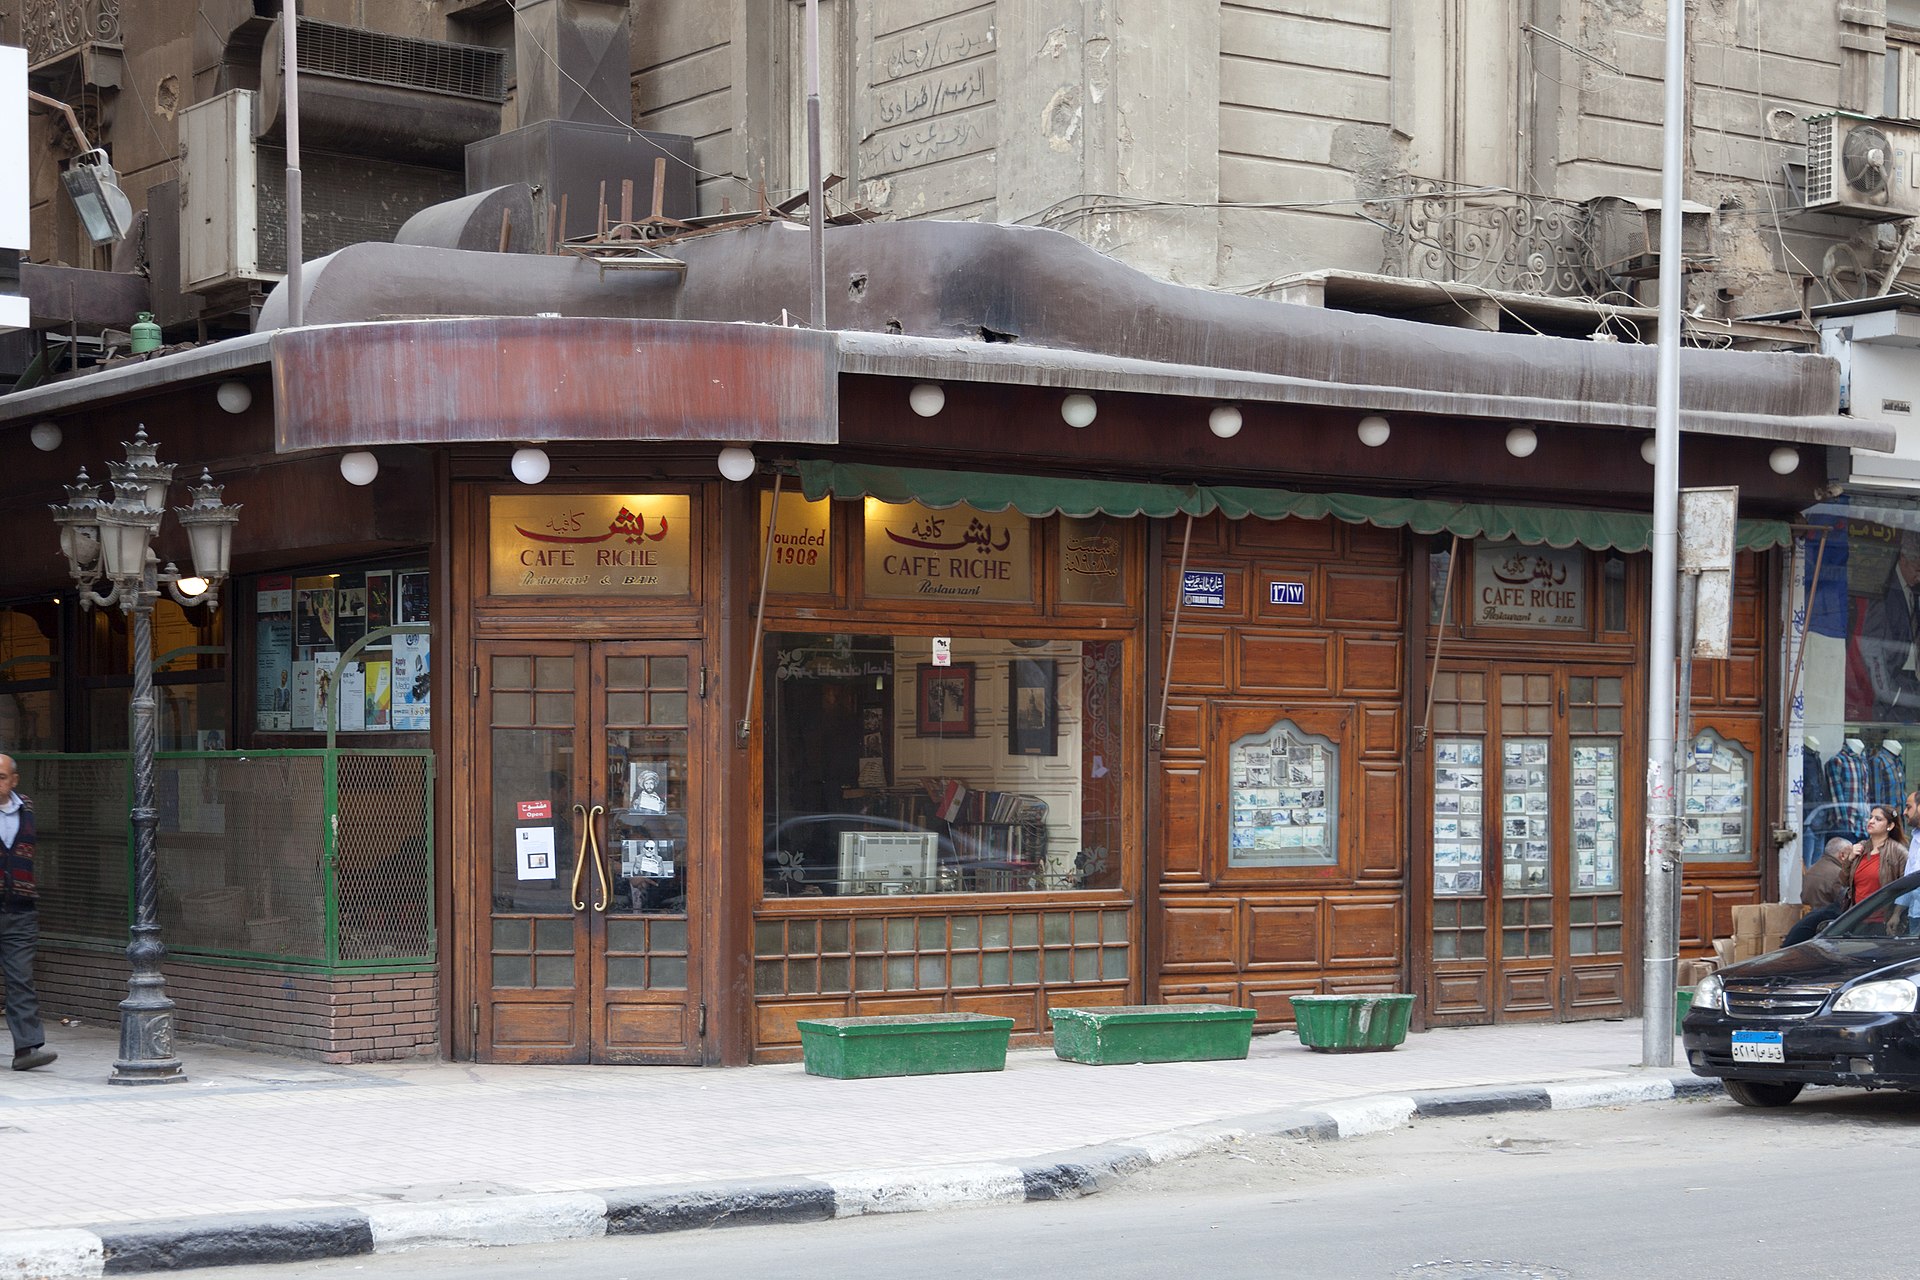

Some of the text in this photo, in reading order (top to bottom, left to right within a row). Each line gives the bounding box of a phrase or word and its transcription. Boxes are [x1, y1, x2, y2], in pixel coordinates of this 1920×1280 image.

[514, 505, 669, 546] كافيه ريش
[884, 514, 1011, 555] كافيه ريش
[596, 549, 658, 567] RICHE
[776, 547, 818, 566] 1908
[949, 557, 1012, 580] RICHE
[1491, 552, 1567, 587] كافيه ريش
[623, 575, 659, 585] BAR
[917, 578, 981, 596] Restaurant
[1207, 575, 1223, 592] شارع
[1273, 585, 1286, 602] 17
[1289, 585, 1302, 601] ١٧
[1531, 589, 1576, 609] RICHE
[1482, 606, 1532, 622] Restaurant
[521, 801, 547, 812] مفتوح
